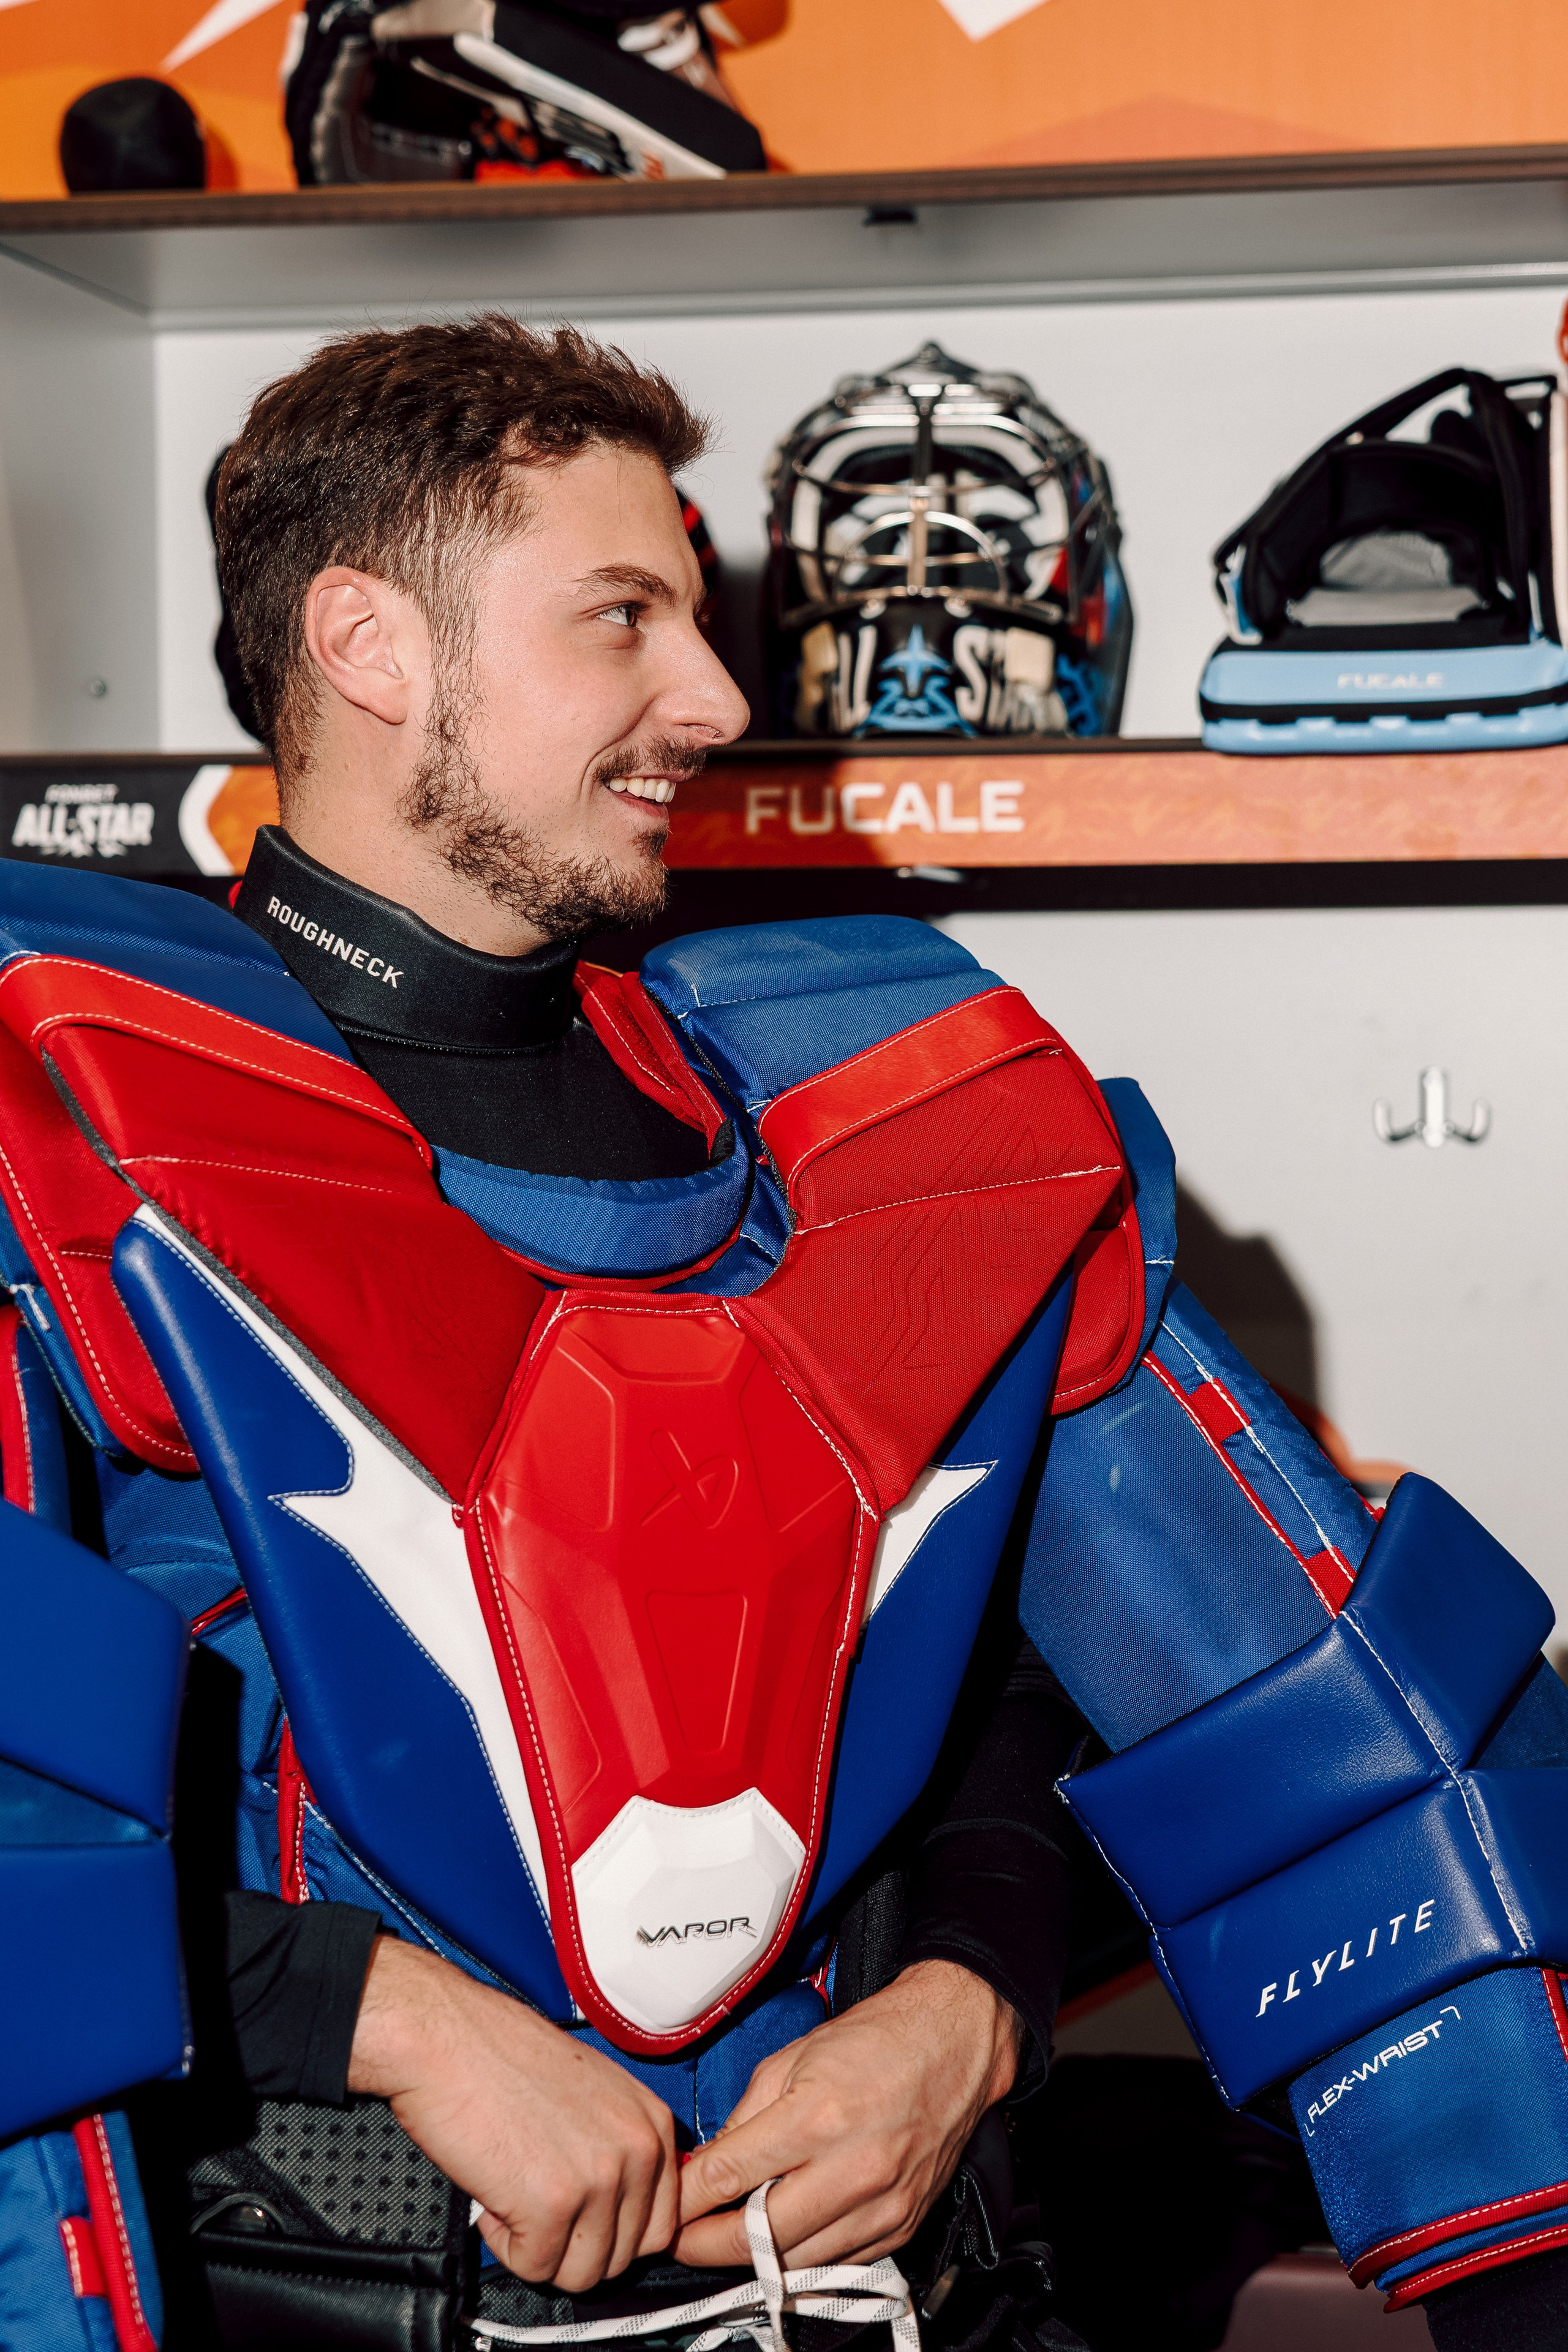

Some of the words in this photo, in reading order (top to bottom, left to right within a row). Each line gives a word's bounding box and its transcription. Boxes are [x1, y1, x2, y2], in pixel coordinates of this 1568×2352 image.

[1336, 672, 1443, 690] FUCALE
[745, 780, 1026, 835] FUCALE
[266, 895, 404, 989] ROUGHNECK
[636, 1916, 758, 1948] VAPOR
[1255, 1898, 1435, 2018] FLYLITE
[1306, 2019, 1443, 2124] FLEX-WRIST
